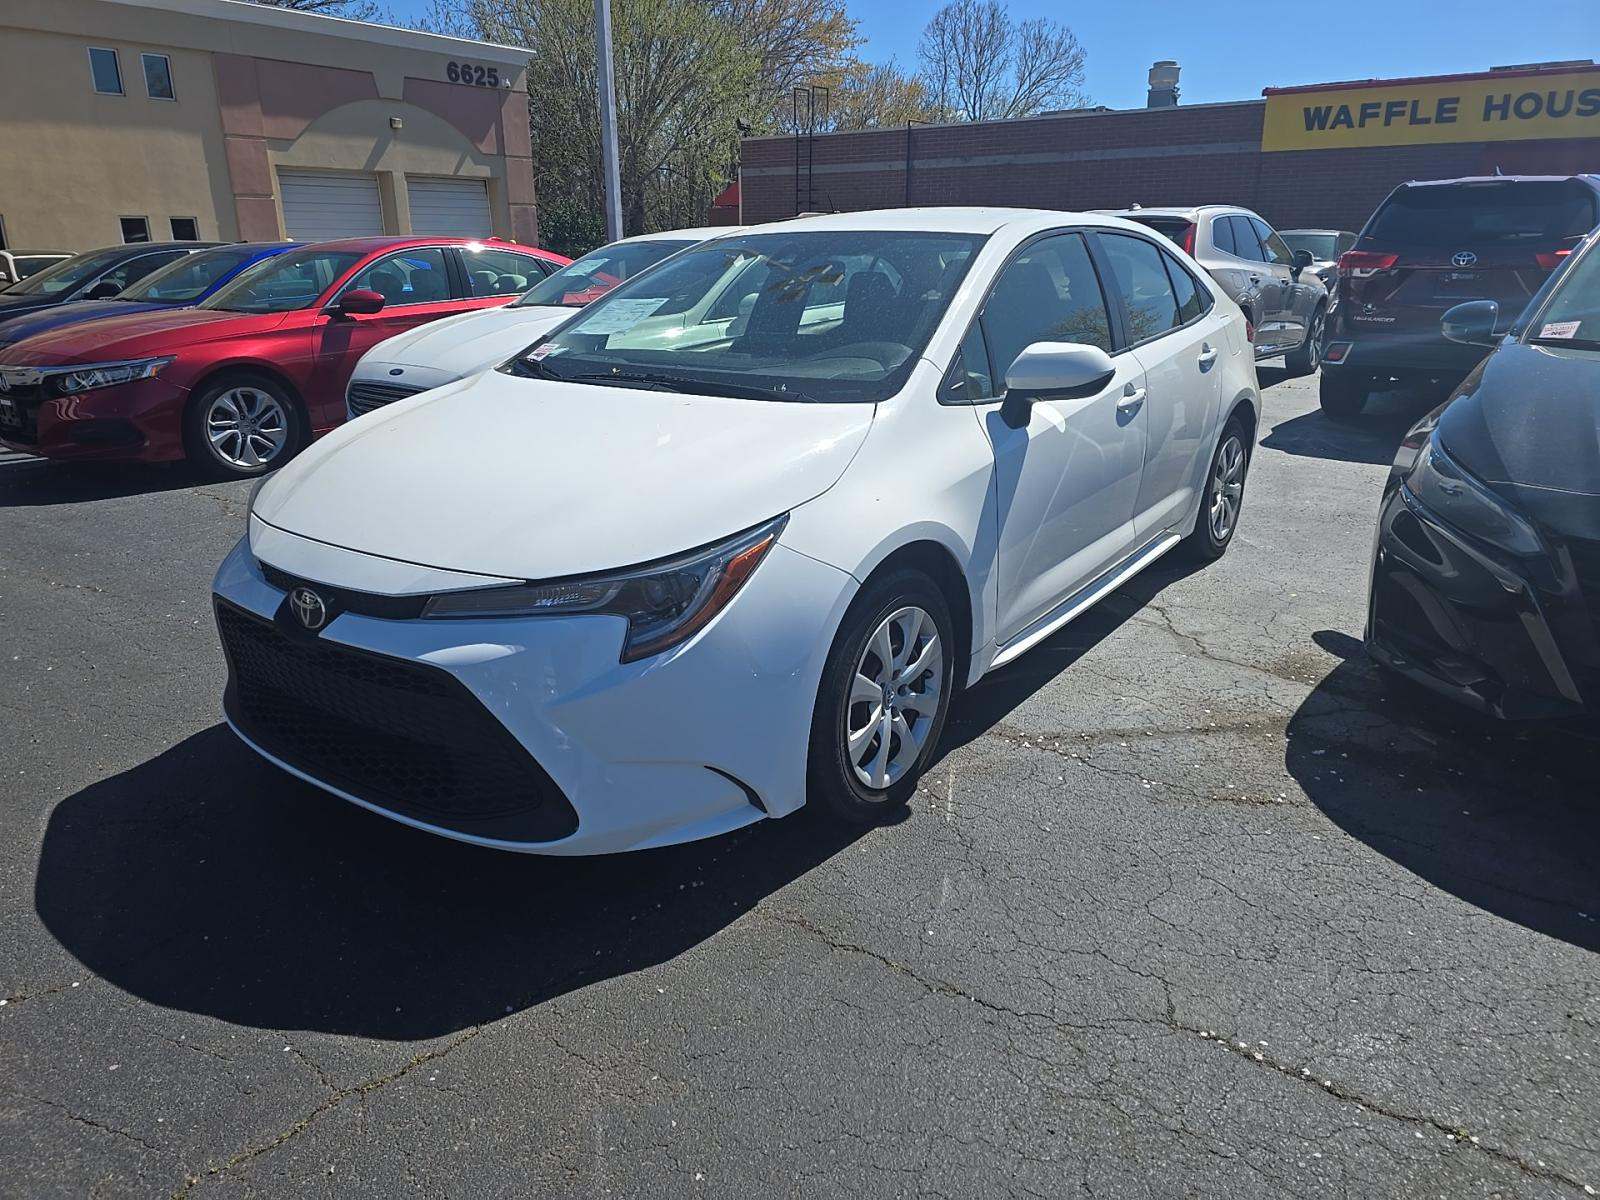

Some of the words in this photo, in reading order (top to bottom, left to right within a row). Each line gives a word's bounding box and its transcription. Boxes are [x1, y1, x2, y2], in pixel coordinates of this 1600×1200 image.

[446, 61, 499, 88] 6625
[1303, 97, 1461, 131] WAFFLE
[1483, 88, 1600, 122] HOUS
